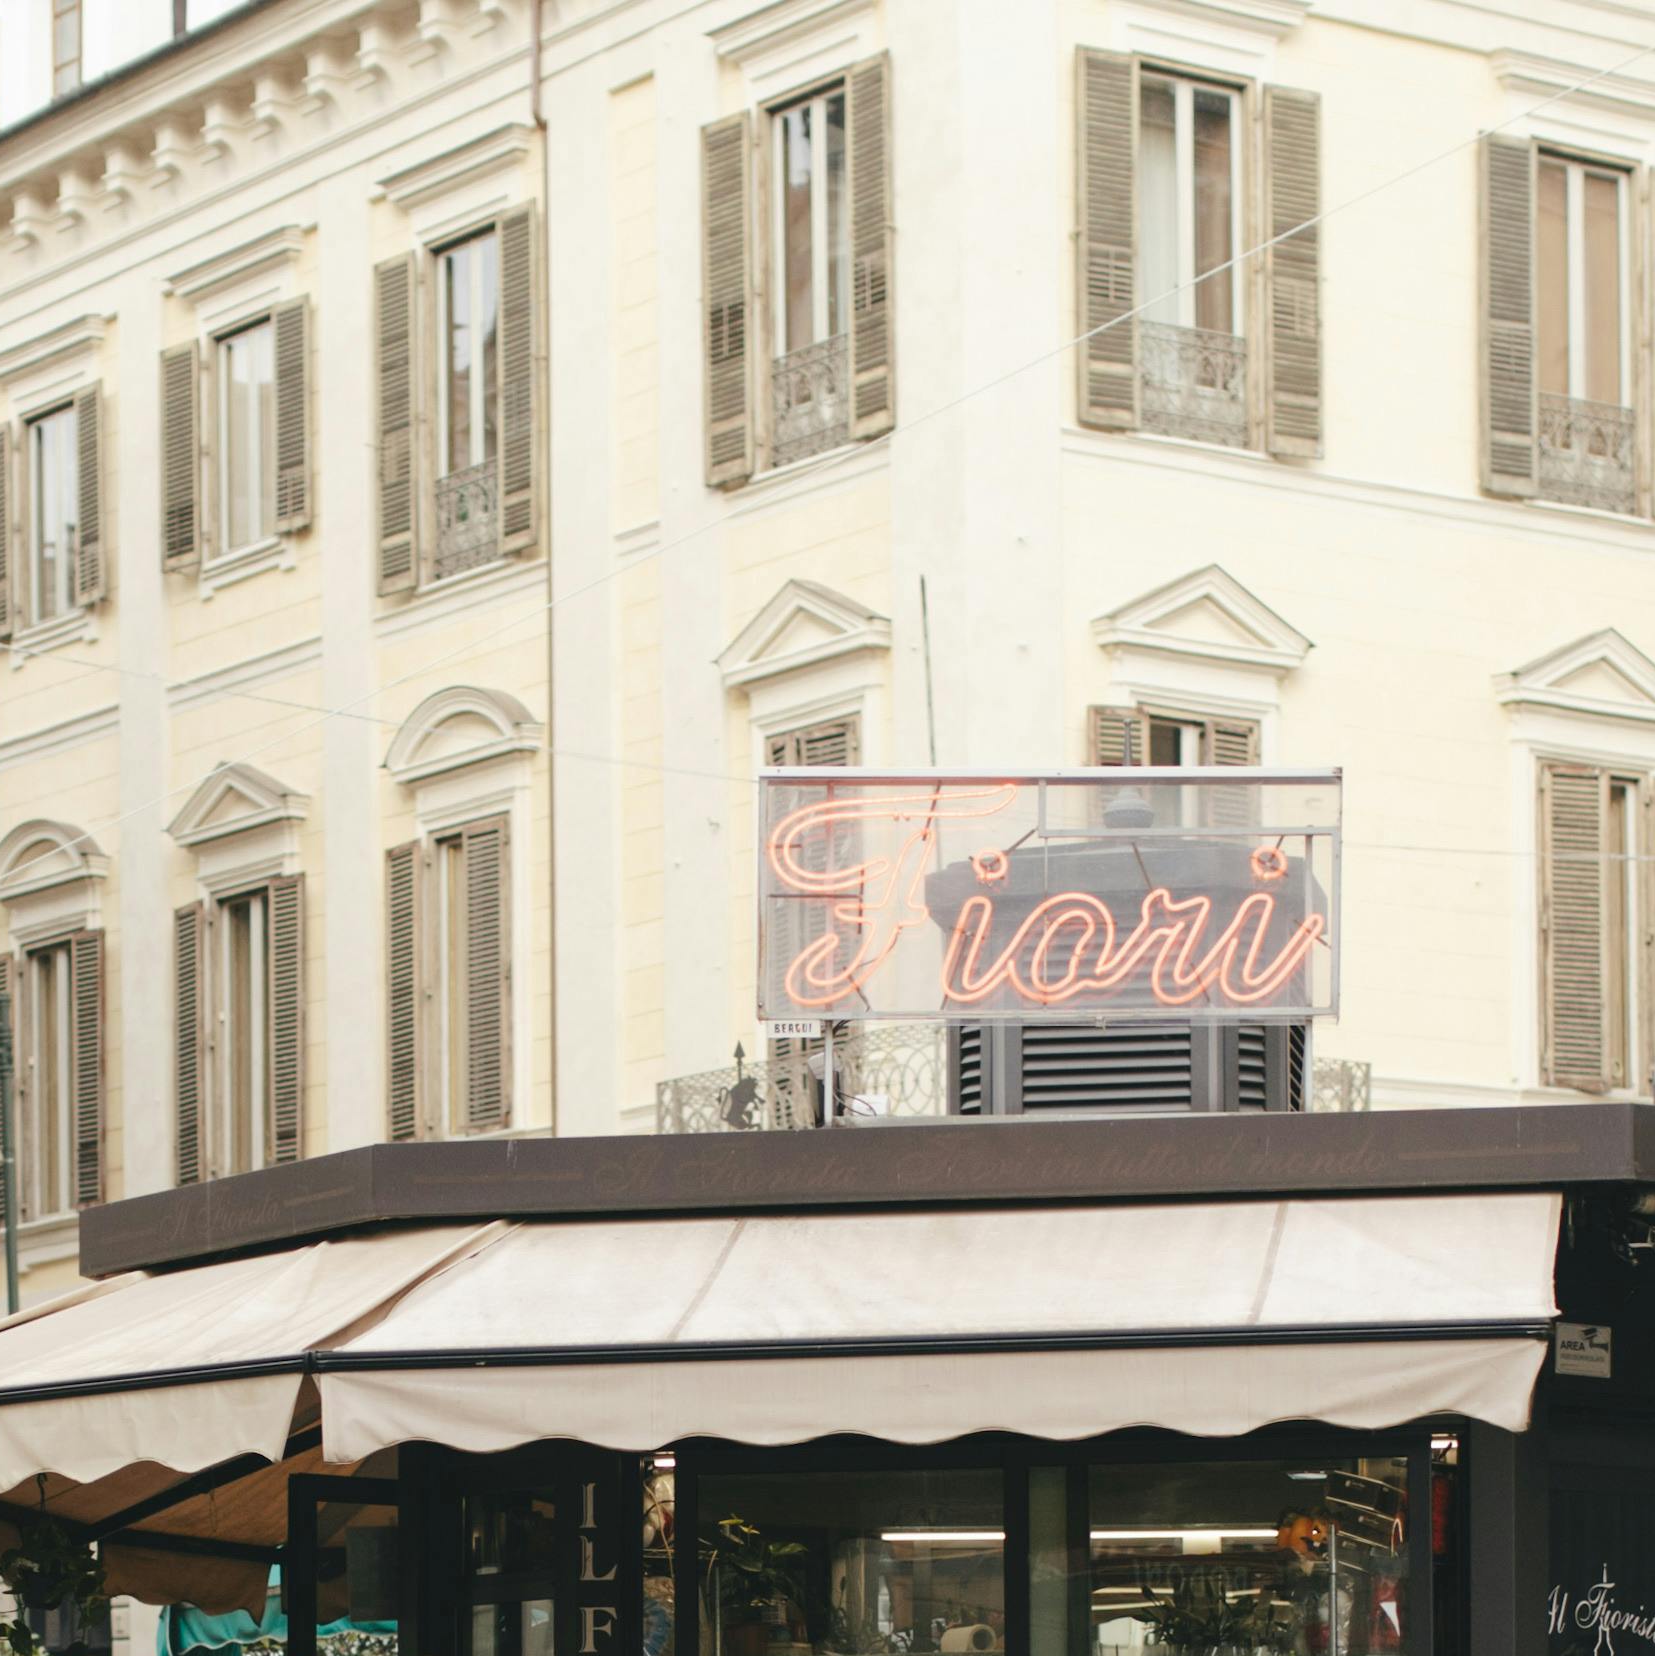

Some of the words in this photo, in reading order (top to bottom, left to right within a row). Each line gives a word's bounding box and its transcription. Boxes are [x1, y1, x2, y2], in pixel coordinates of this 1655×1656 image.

[766, 782, 1325, 1006] Fiori
[1559, 1340, 1585, 1352] AREA
[579, 1482, 619, 1582] IL
